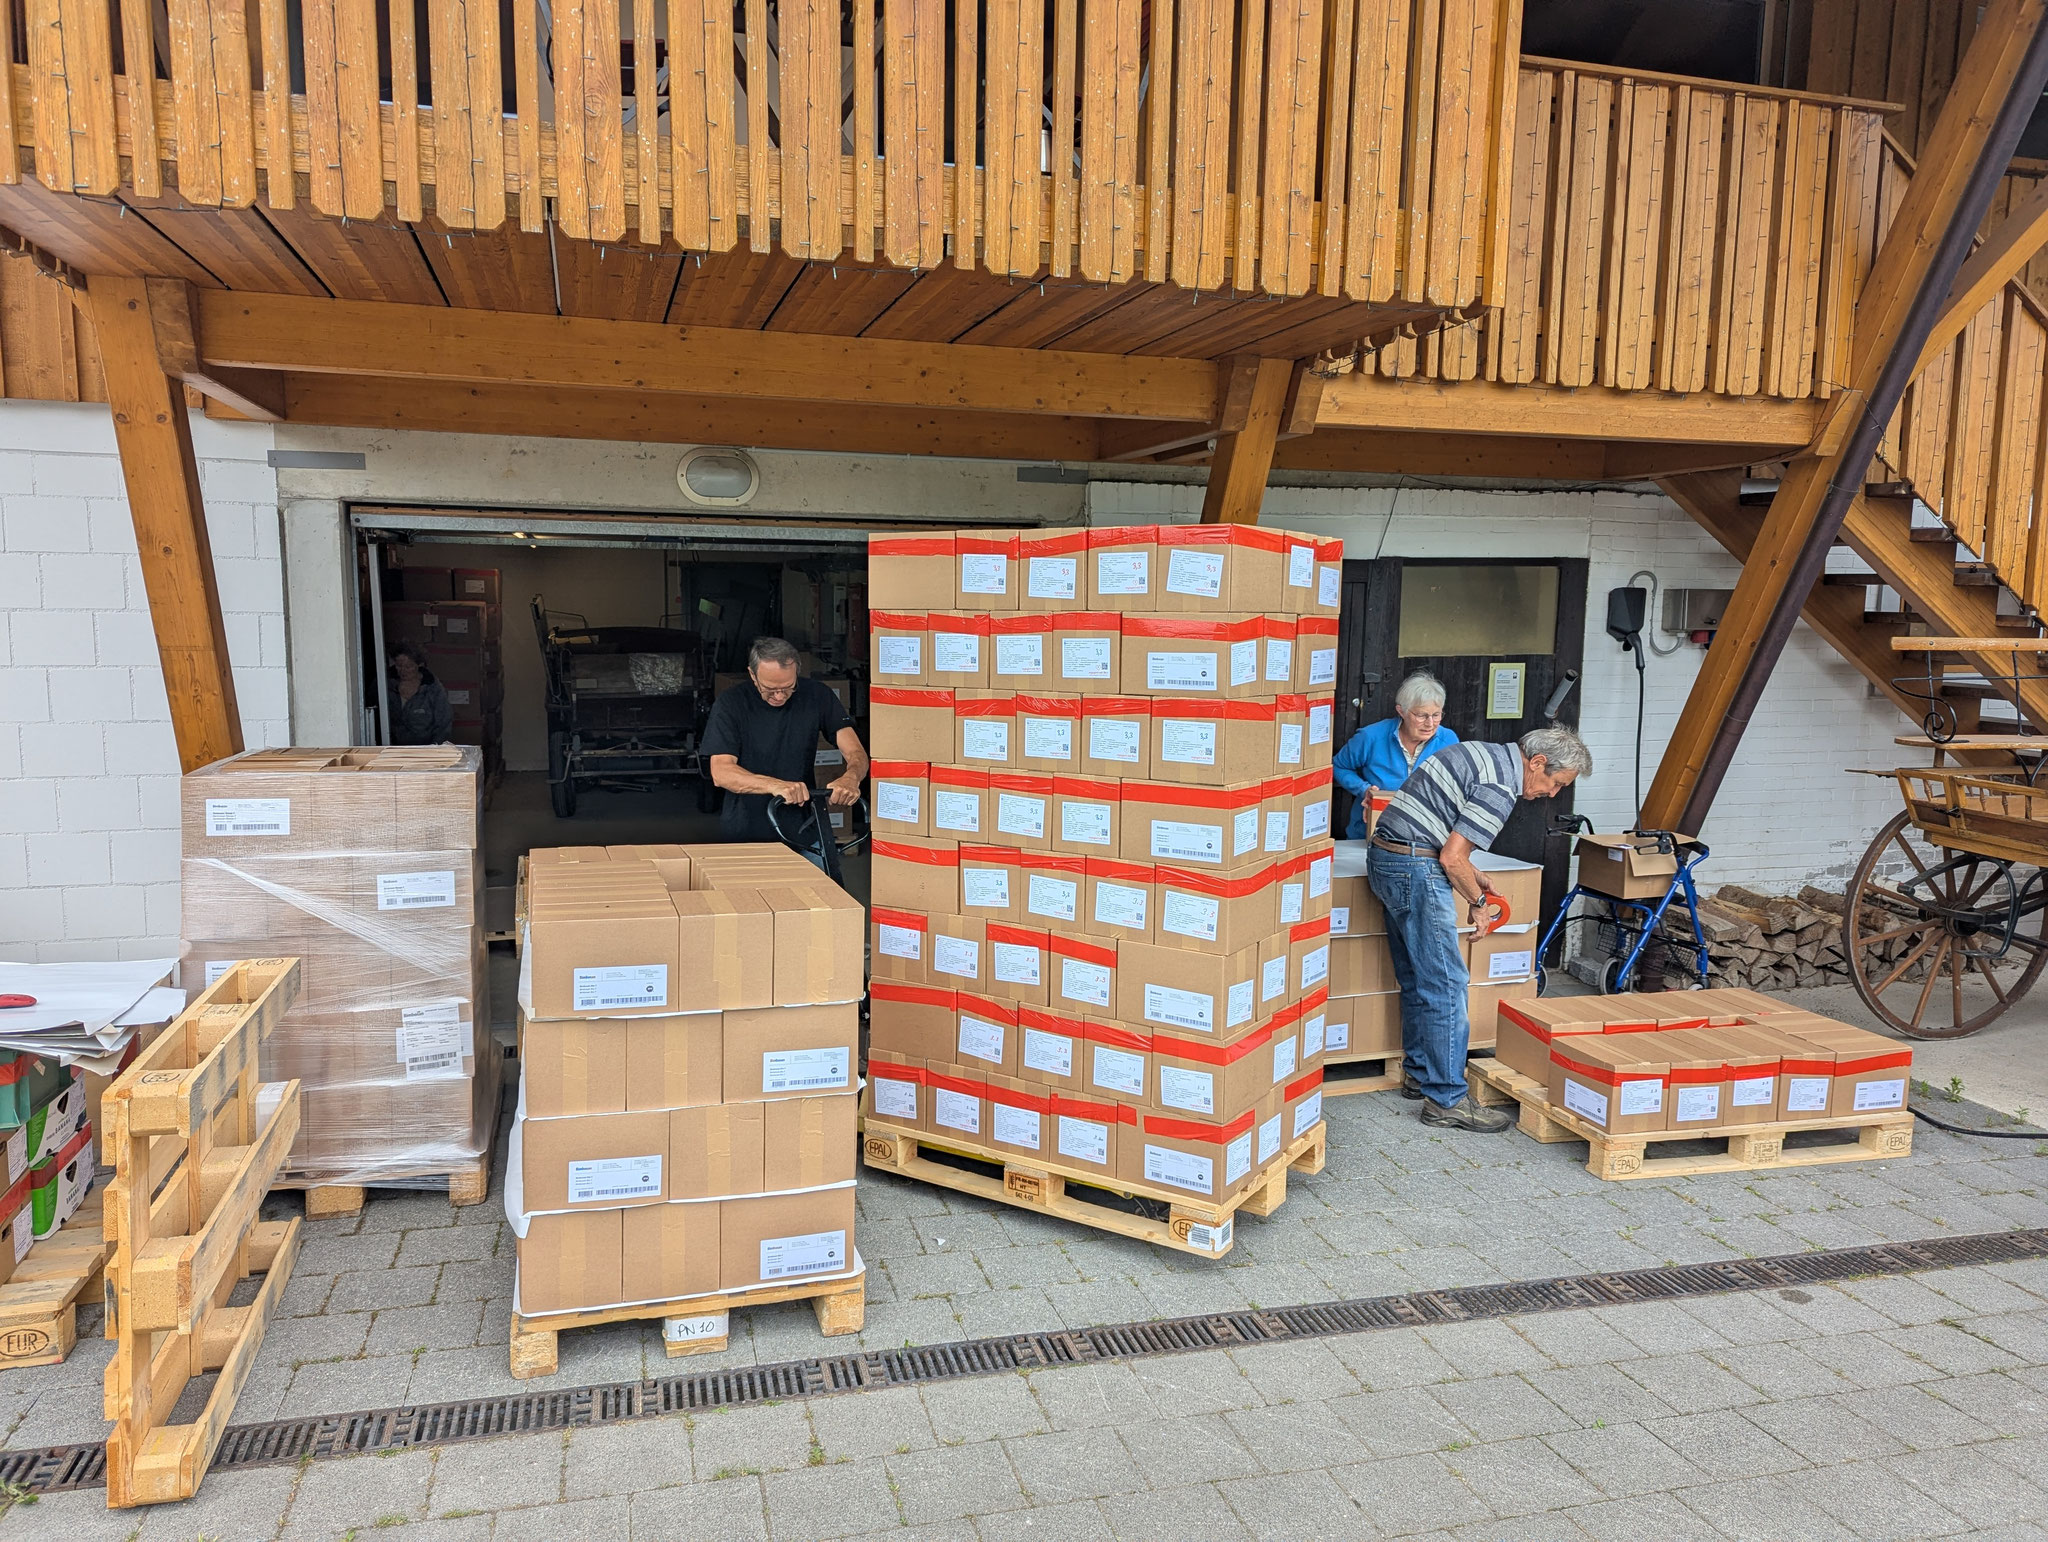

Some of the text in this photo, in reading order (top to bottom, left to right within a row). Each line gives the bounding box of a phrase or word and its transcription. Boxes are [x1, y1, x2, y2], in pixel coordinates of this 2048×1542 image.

[869, 1141, 887, 1156] EPAL
[677, 1320, 715, 1337] PN 10
